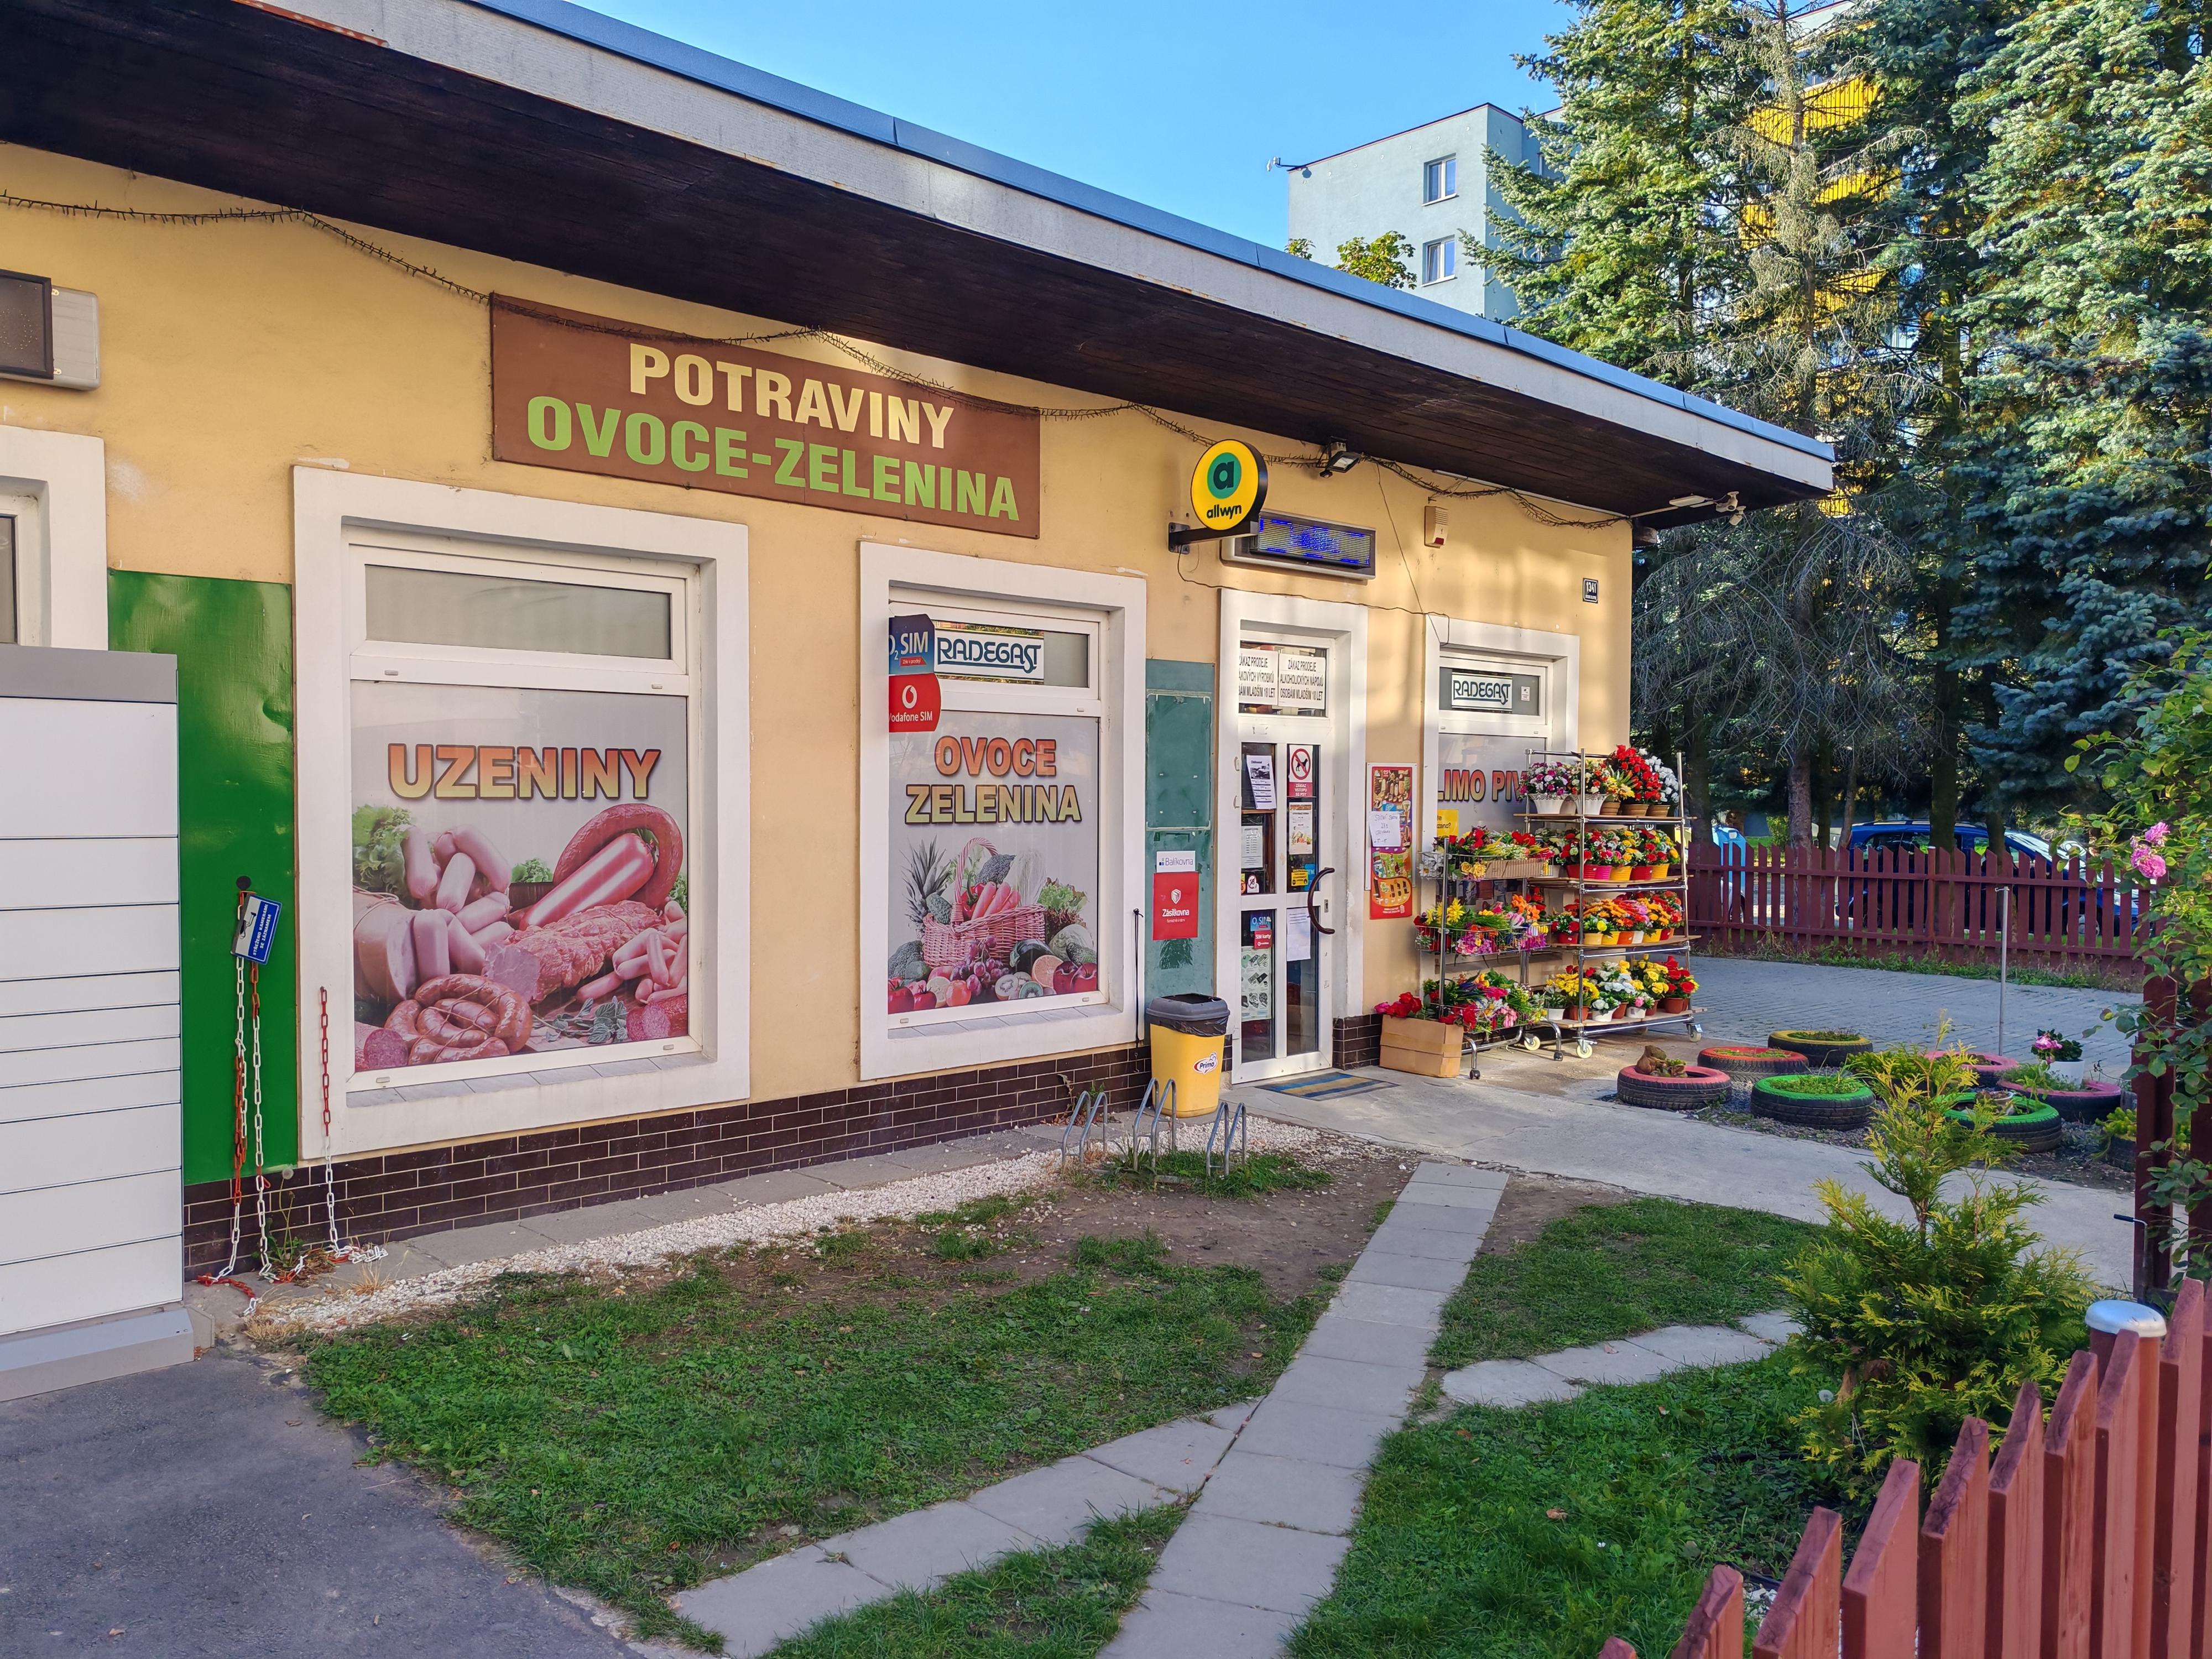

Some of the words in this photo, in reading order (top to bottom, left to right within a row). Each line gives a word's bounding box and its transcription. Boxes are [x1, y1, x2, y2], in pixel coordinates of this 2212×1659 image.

[629, 342, 954, 449] POTRAVINY
[526, 395, 1020, 521] OVOCE-ZELENINA
[1206, 504, 1242, 519] allwyn
[1586, 581, 1597, 593] 1341
[900, 631, 928, 655] SIM
[937, 637, 1041, 674] RADEGAST
[1251, 656, 1268, 667] PRODEJE
[1288, 658, 1300, 670] ZÁKAZ
[1300, 661, 1316, 672] PRODEJE
[1280, 673, 1310, 686] ALKOHOLICKÝCH
[1310, 674, 1323, 687] NÁPOJŮ
[1246, 685, 1263, 697] MLADŠÍM
[1264, 687, 1268, 697] 18
[1280, 686, 1295, 698] OSOBÁM
[1296, 687, 1311, 700] MLADŠÍM
[1312, 691, 1316, 700] 18
[1453, 680, 1511, 705] RADEGAST
[920, 711, 933, 721] SIM
[934, 735, 1057, 776] OVOCE
[388, 743, 661, 800] UZENINY
[905, 784, 1082, 825] ZELENINA
[1165, 857, 1193, 867] Balíkovna
[1162, 908, 1190, 917] Zásilkovna
[253, 931, 262, 956] STŘEŽENO
[259, 904, 268, 931] KAMERAMI
[262, 914, 272, 941] ZÁZNAMEM
[1199, 1062, 1215, 1070] Prima
